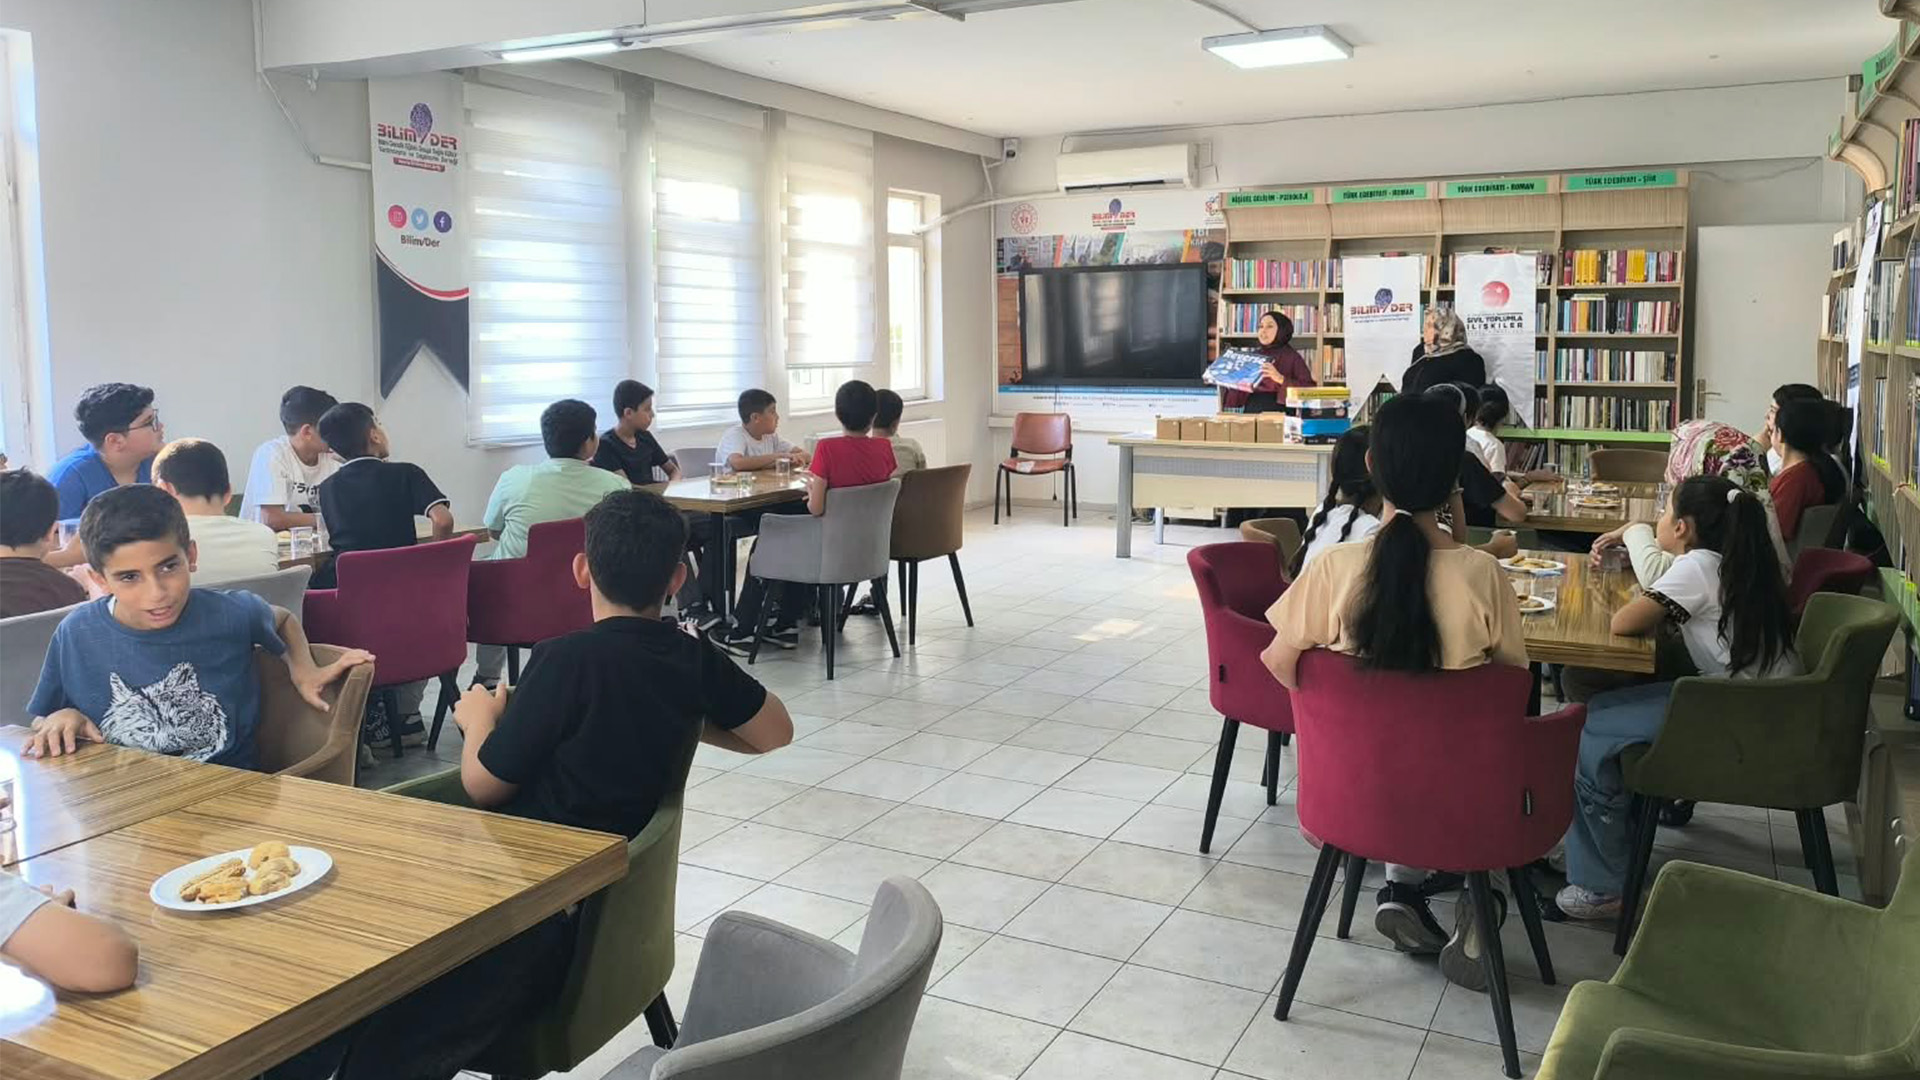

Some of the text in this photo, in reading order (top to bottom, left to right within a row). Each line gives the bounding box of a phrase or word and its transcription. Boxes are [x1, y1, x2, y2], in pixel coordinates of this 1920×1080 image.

[1585, 177, 1602, 186] TÜRK
[1457, 184, 1473, 193] TÜRK
[1511, 182, 1535, 191] ROMAN
[1485, 315, 1523, 323] TOPLUMLA
